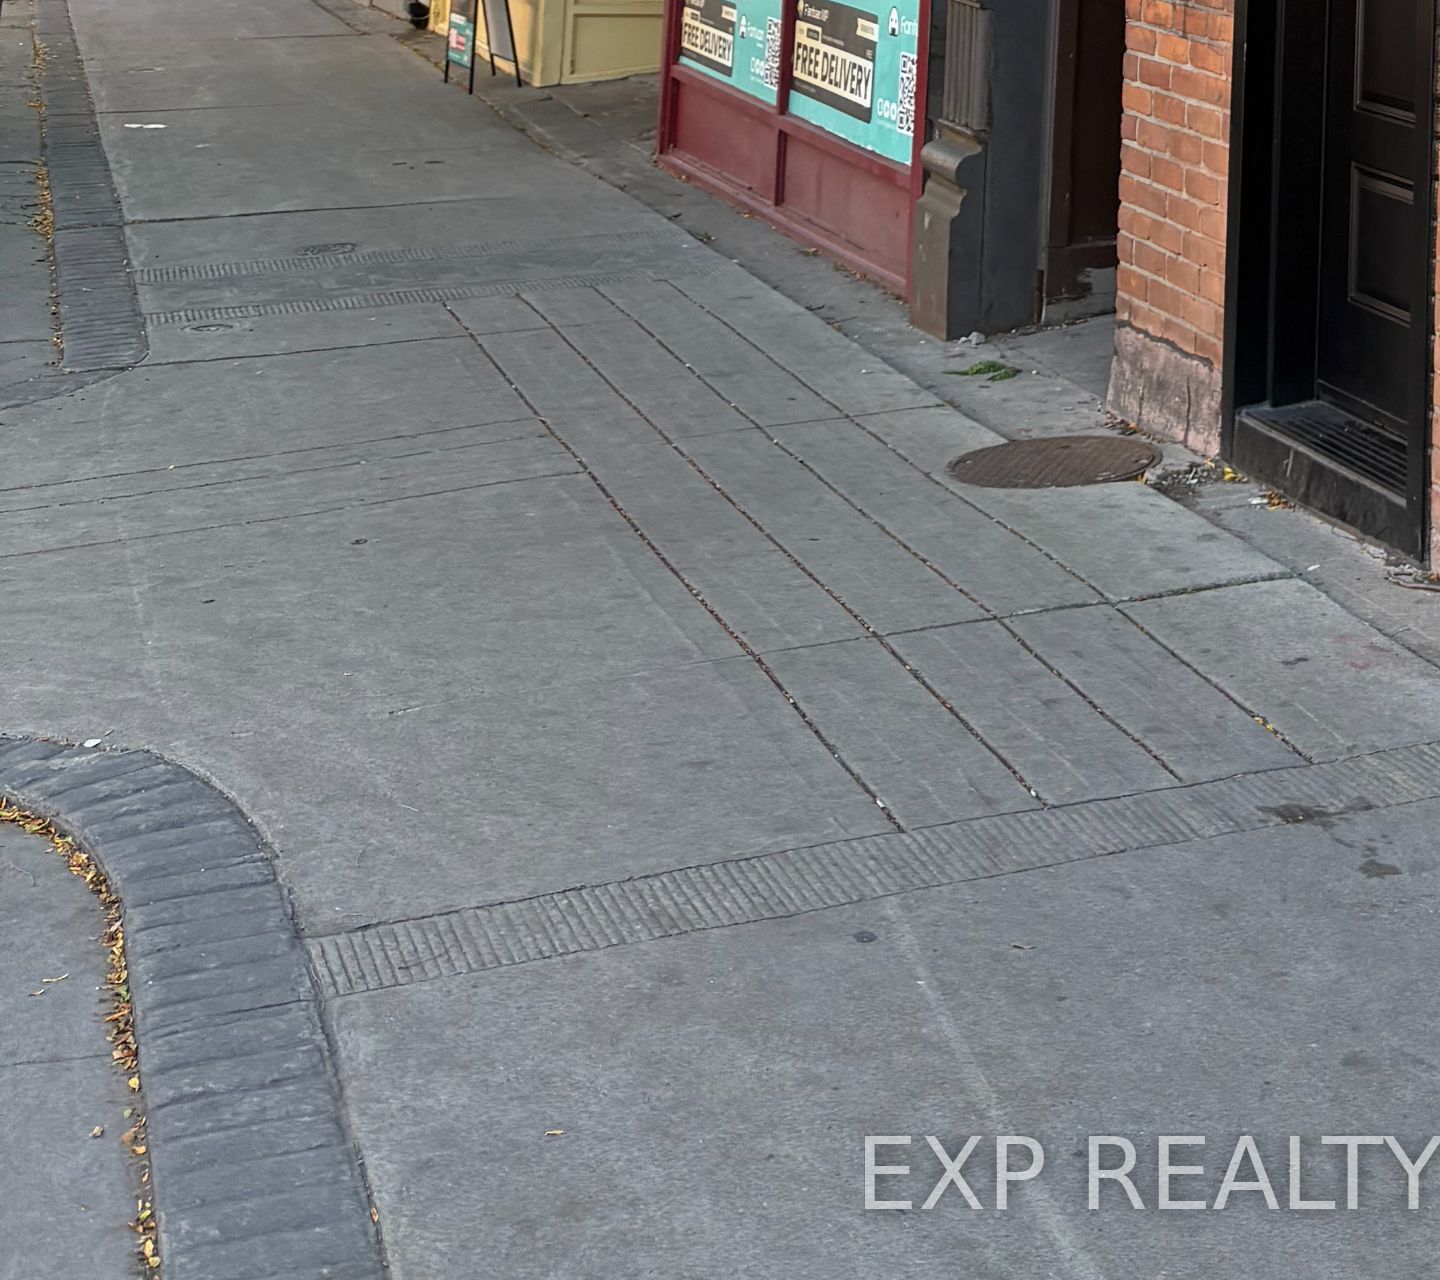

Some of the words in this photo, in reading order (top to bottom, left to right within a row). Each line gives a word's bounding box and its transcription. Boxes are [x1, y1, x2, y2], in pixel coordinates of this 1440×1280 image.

[684, 23, 700, 48] FREE
[700, 27, 733, 62] DELIVERY
[794, 41, 820, 81] FREE
[820, 50, 871, 100] DELIVERY
